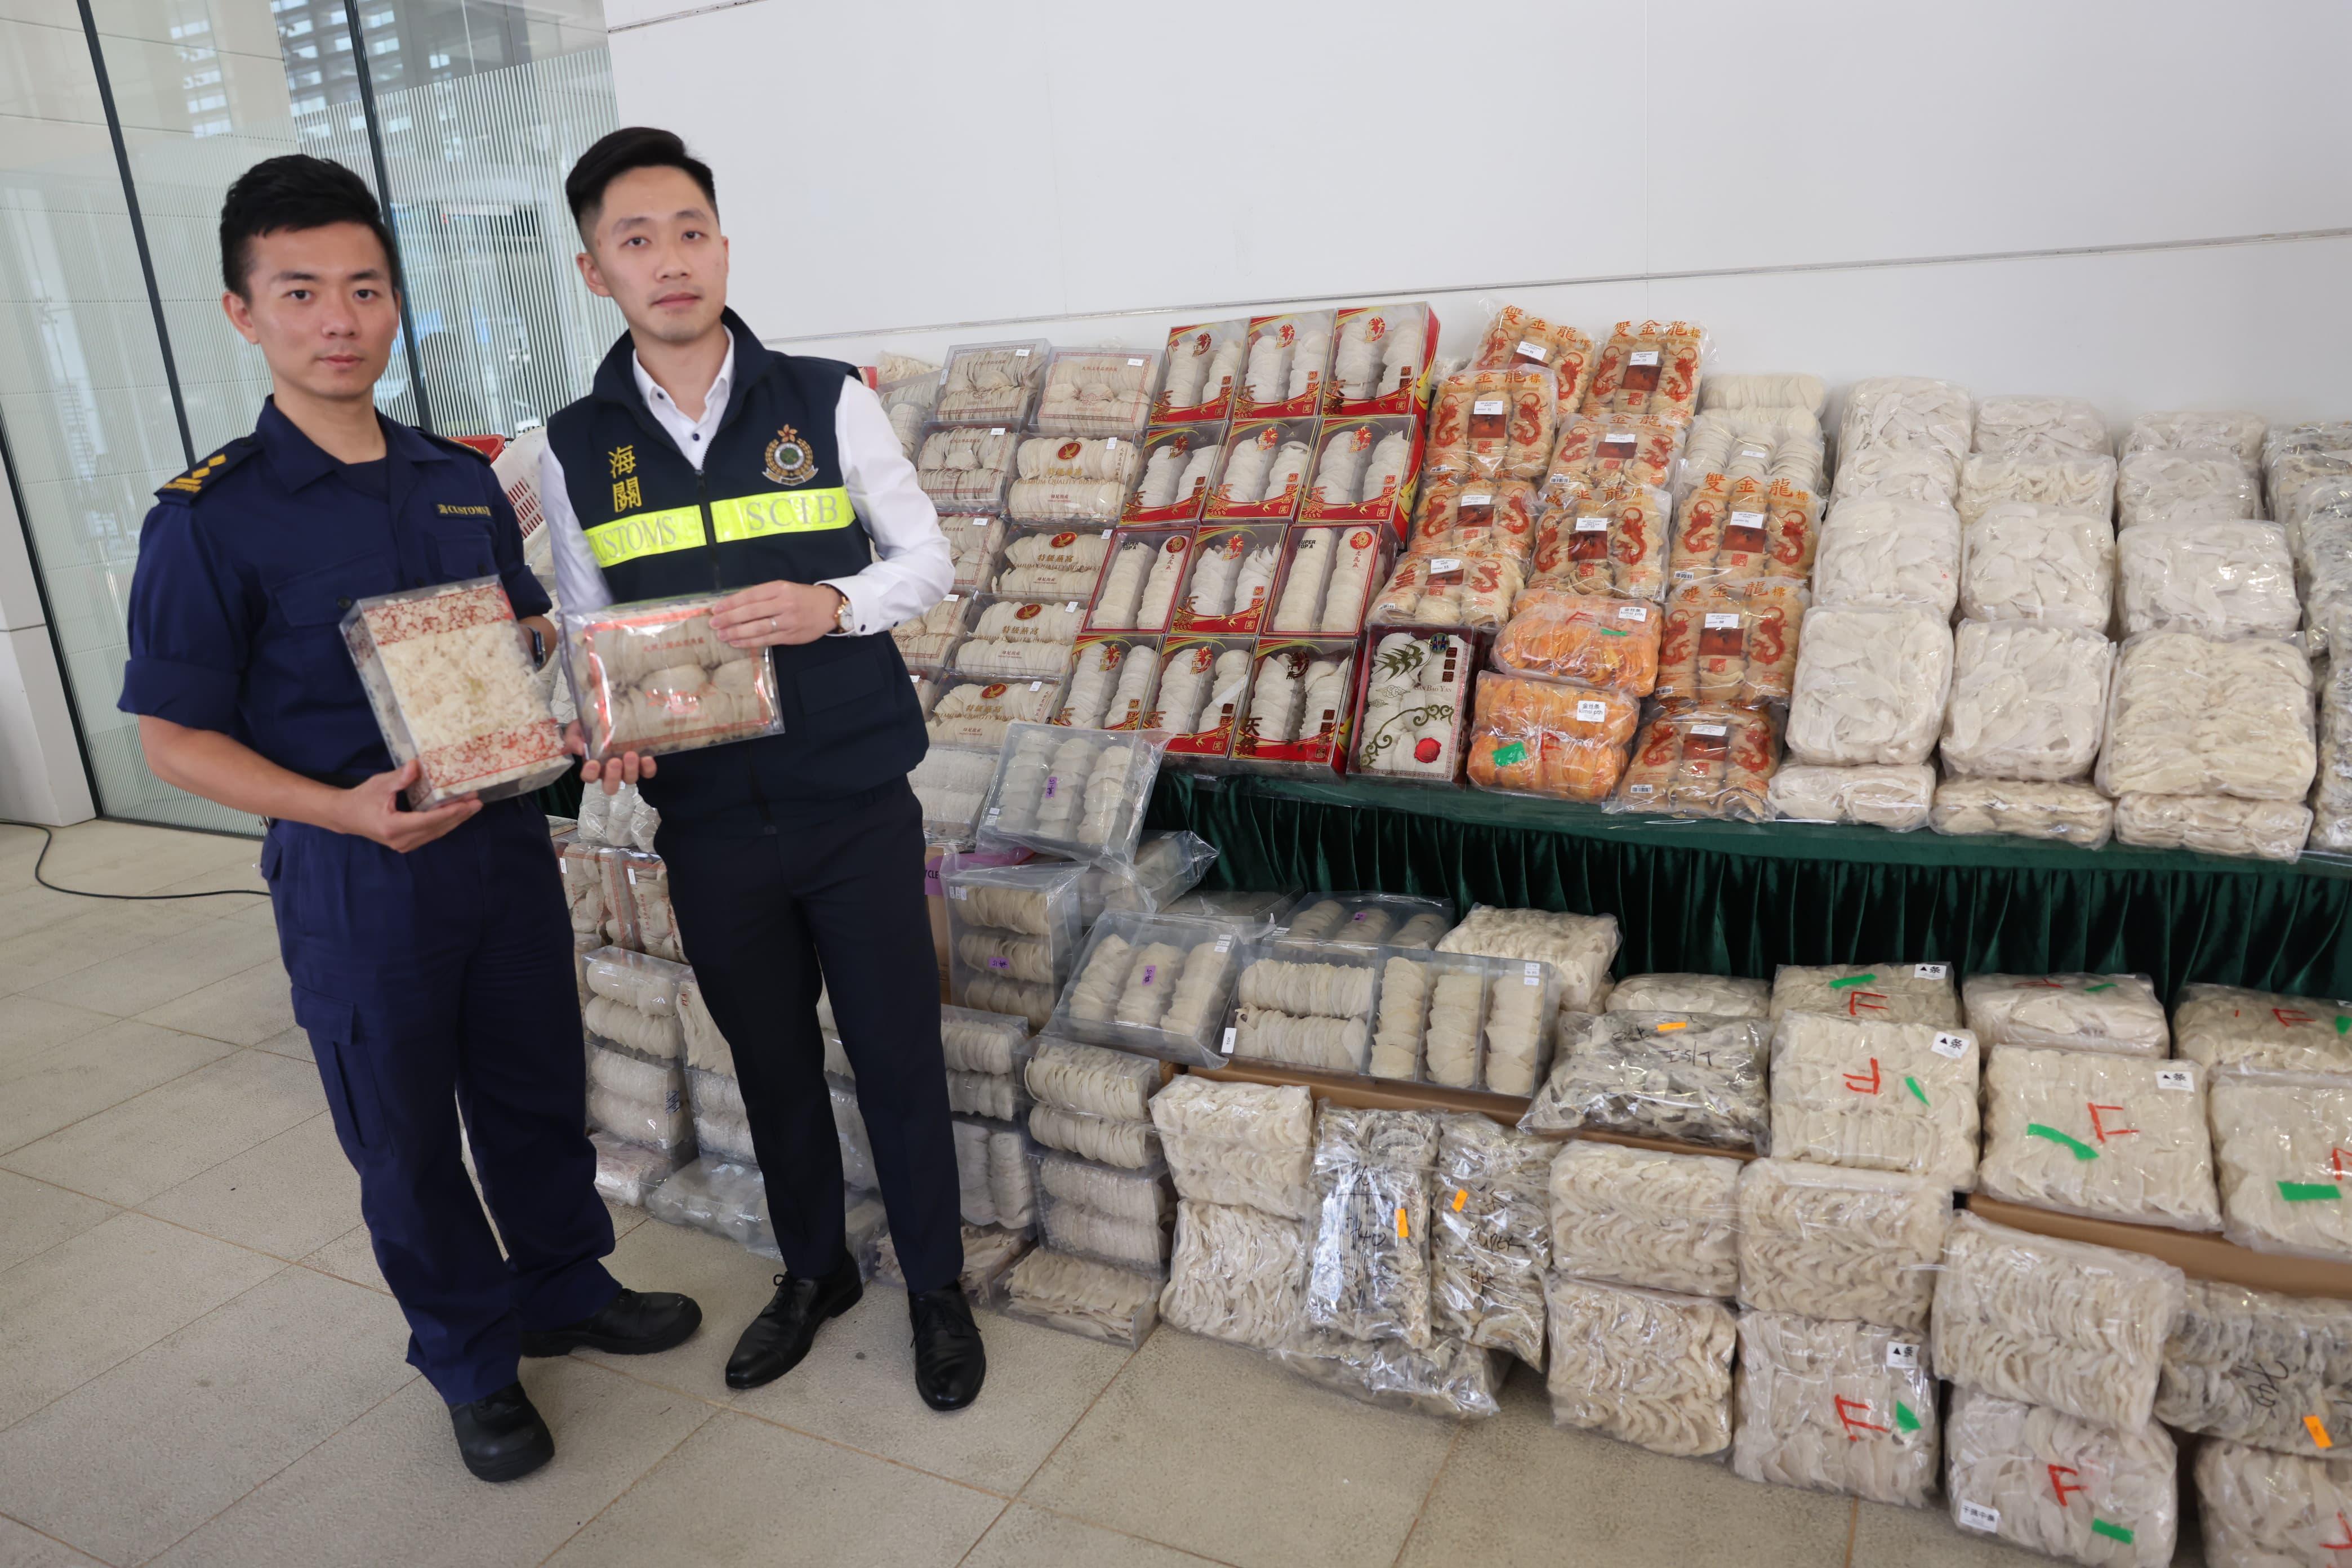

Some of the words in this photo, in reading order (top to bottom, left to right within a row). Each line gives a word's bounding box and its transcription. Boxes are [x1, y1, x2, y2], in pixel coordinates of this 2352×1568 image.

[1612, 320, 1701, 338] 雙金龍標
[608, 444, 642, 513] 海關
[1703, 472, 1808, 501] 雙金龍標
[447, 505, 487, 515] CUSTOMS
[746, 495, 839, 531] SCIB
[1037, 554, 1074, 563] 特級燕窩
[1002, 625, 1039, 635] 特級燕窩
[966, 704, 1003, 713] 特級燕窩
[1949, 1039, 1962, 1049] 条
[1834, 1394, 1893, 1442] F
[2048, 1463, 2089, 1508] F
